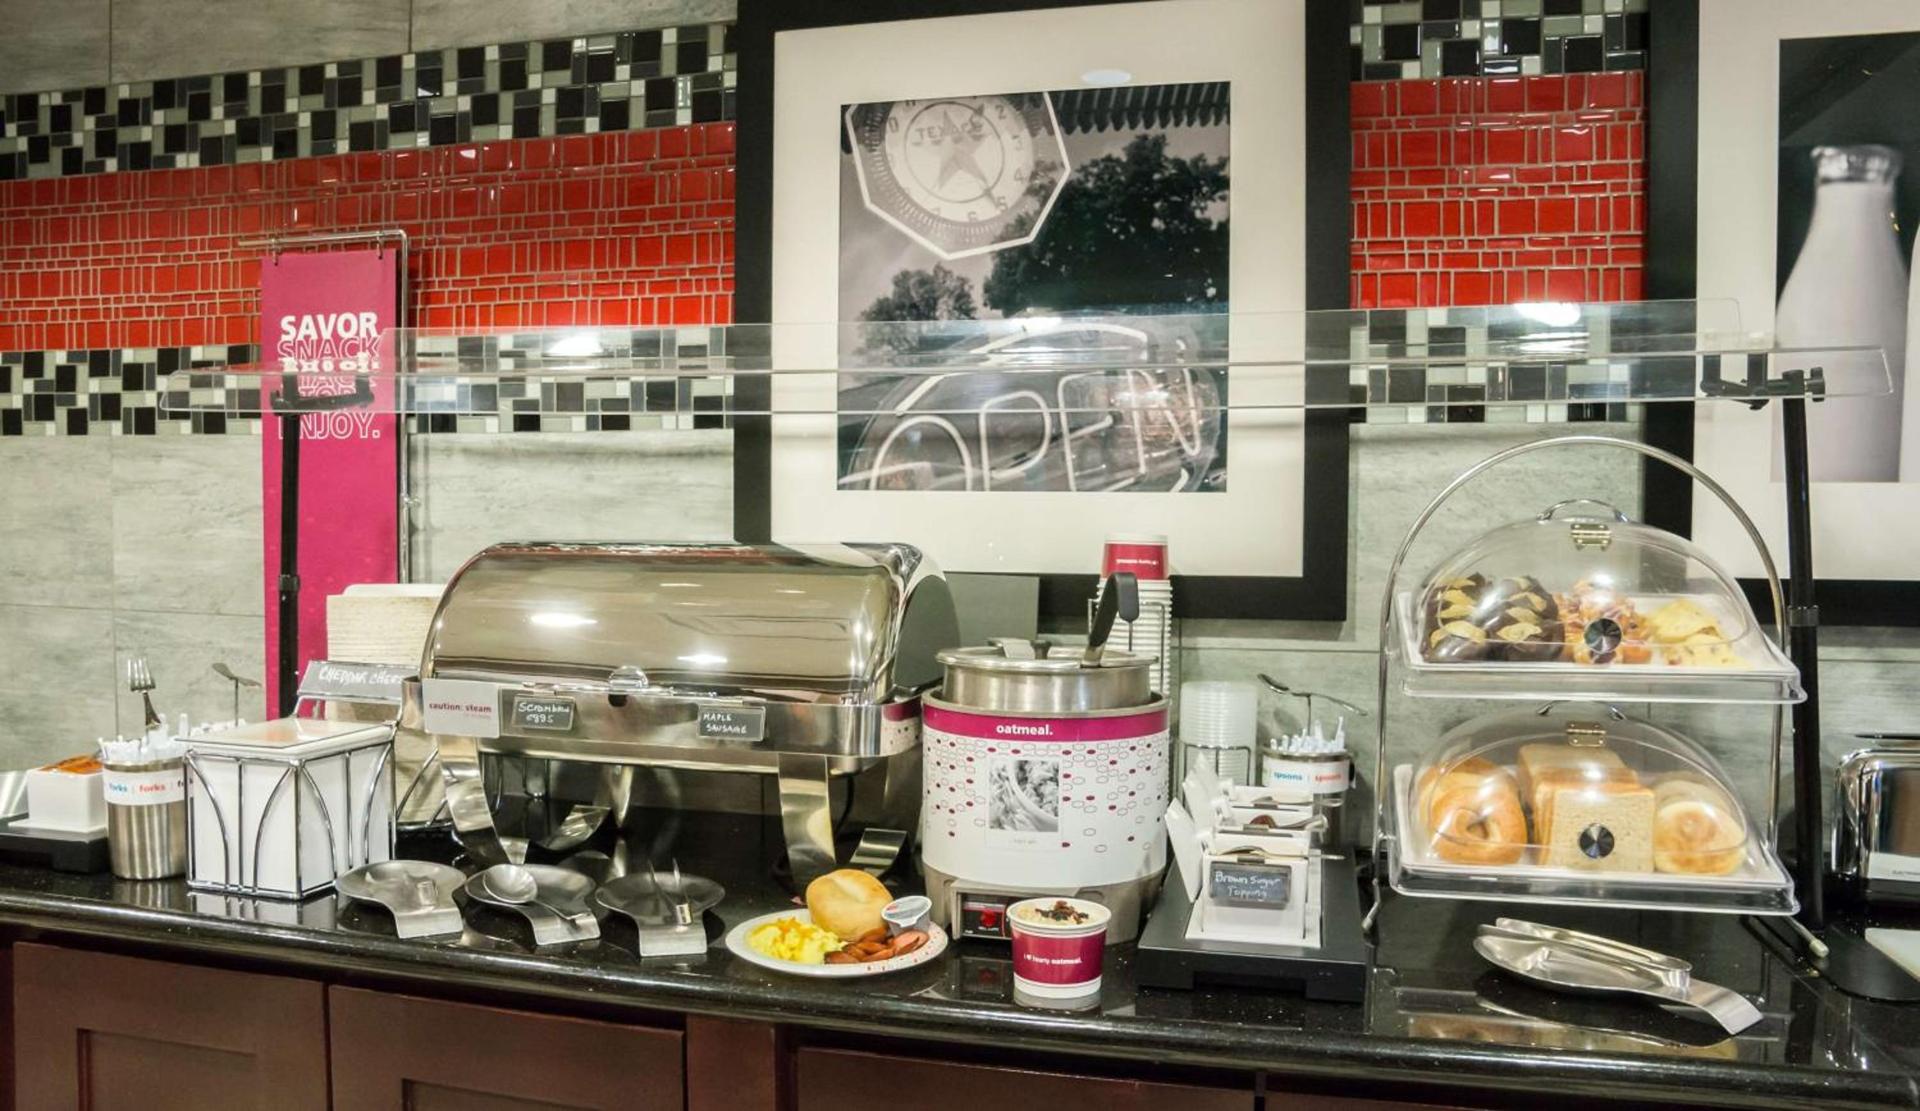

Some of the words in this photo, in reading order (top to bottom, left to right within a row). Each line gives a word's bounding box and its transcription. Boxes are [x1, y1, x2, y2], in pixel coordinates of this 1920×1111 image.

[280, 311, 378, 340] SAVOR
[277, 337, 381, 360] SNACK
[465, 704, 492, 712] steam
[996, 724, 1053, 735] oatmeal.
[1215, 871, 1248, 884] Brown
[1249, 876, 1281, 888] Sugar
